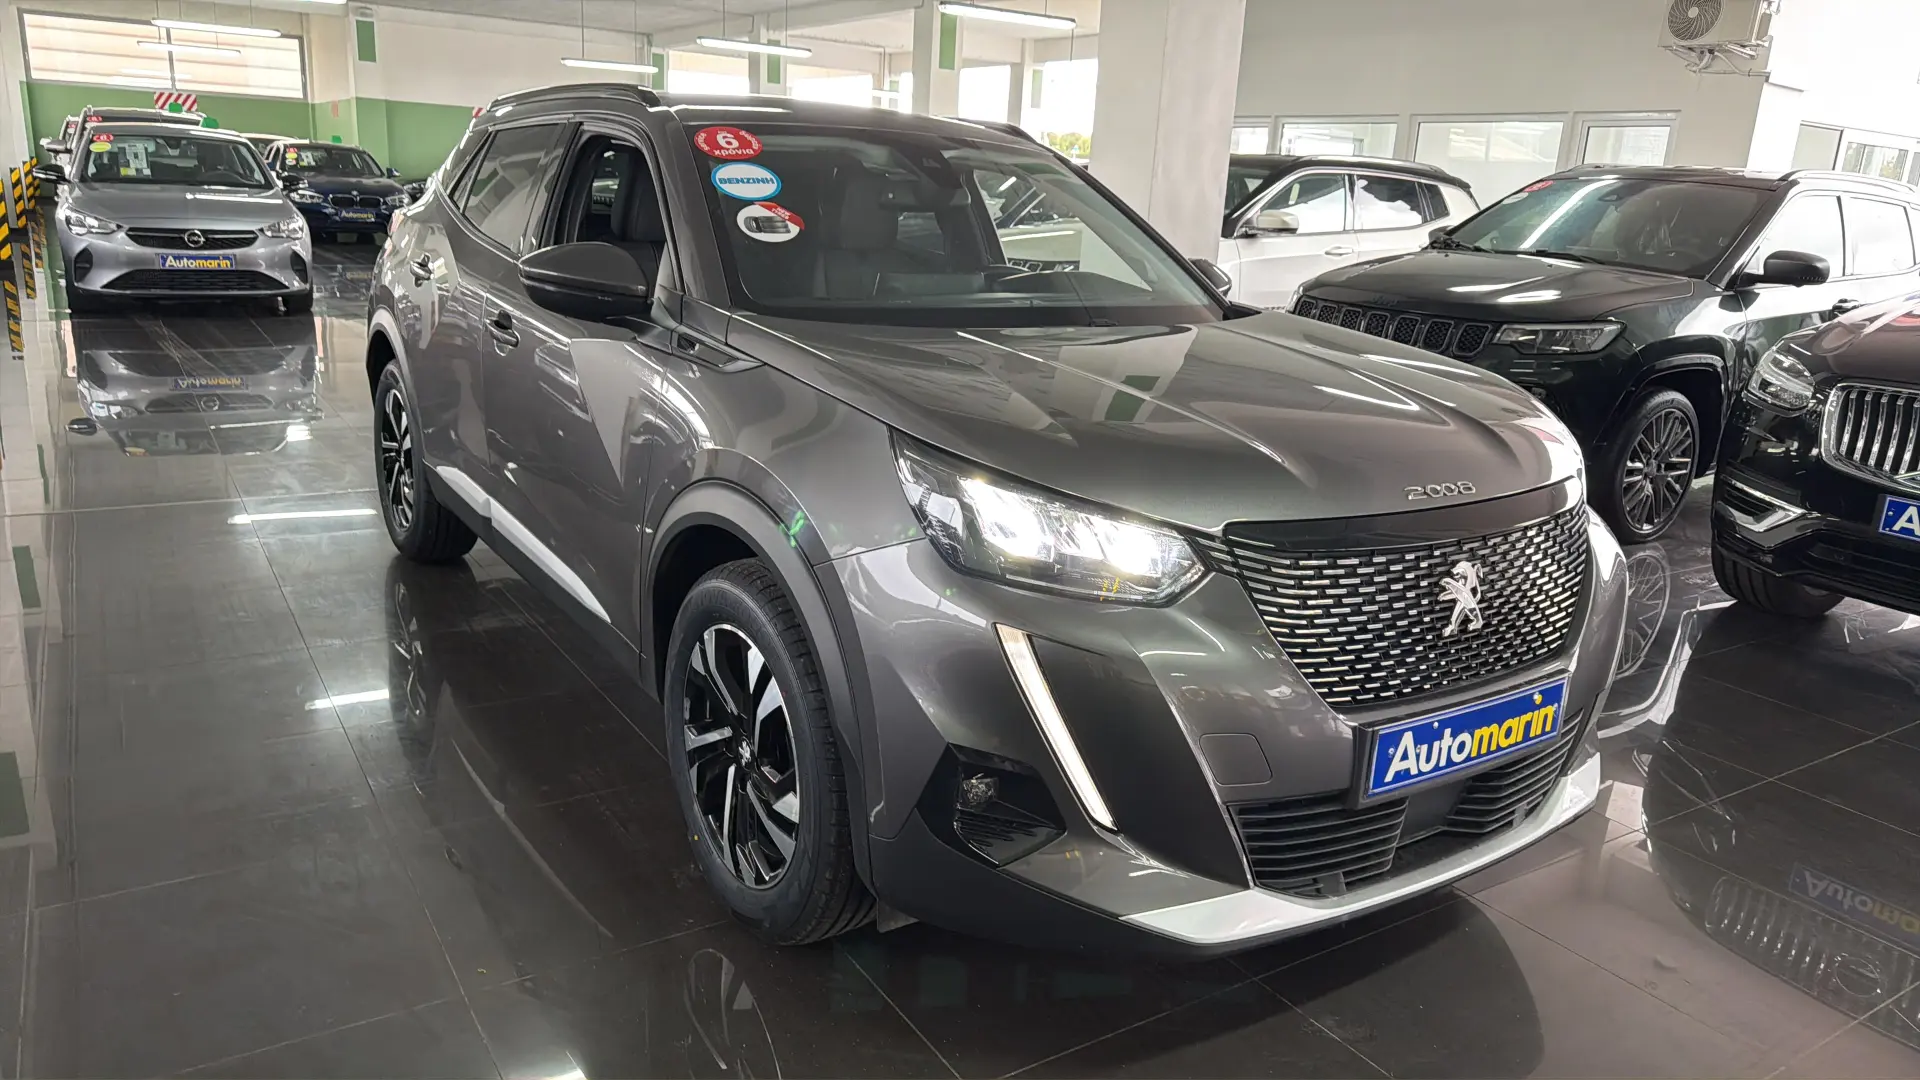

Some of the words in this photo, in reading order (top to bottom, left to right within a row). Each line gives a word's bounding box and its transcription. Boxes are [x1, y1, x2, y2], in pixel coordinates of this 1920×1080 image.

[716, 132, 739, 149] 6
[713, 148, 754, 156] χρόνια
[341, 210, 374, 219] Automarin
[165, 255, 231, 269] Automarin
[1404, 481, 1476, 500] 2008
[1384, 695, 1557, 783] Automarin
